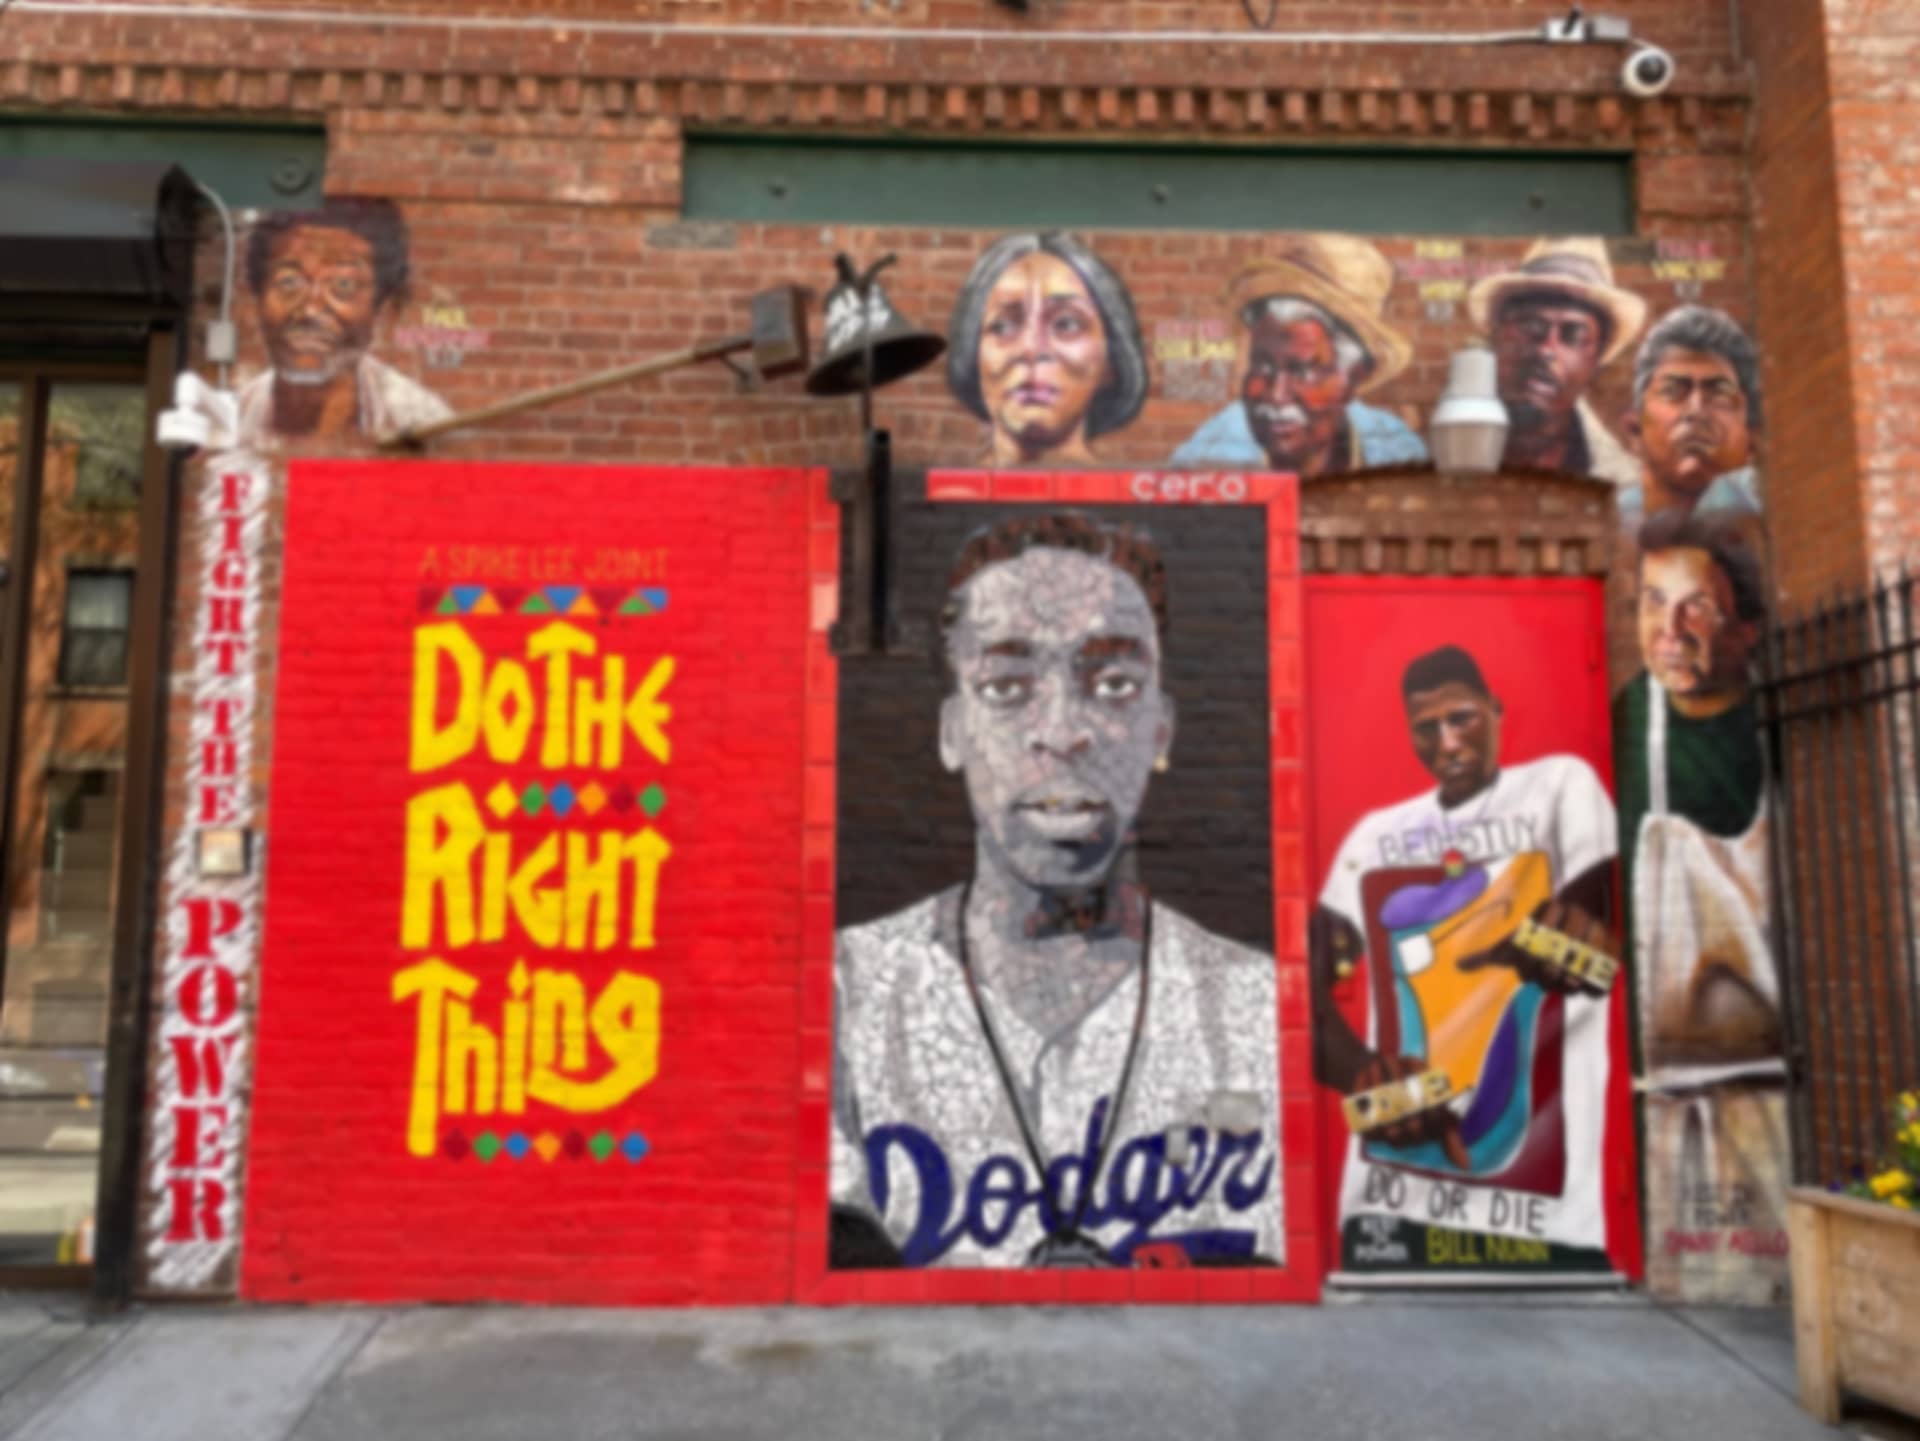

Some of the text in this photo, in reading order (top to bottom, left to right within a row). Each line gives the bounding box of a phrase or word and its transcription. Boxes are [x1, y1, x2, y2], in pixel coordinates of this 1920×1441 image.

[164, 473, 253, 1242] FIGHT THE POWER
[1427, 1180, 1469, 1222] OR
[1488, 1188, 1545, 1237] DIE
[1426, 1224, 1481, 1264] BILL
